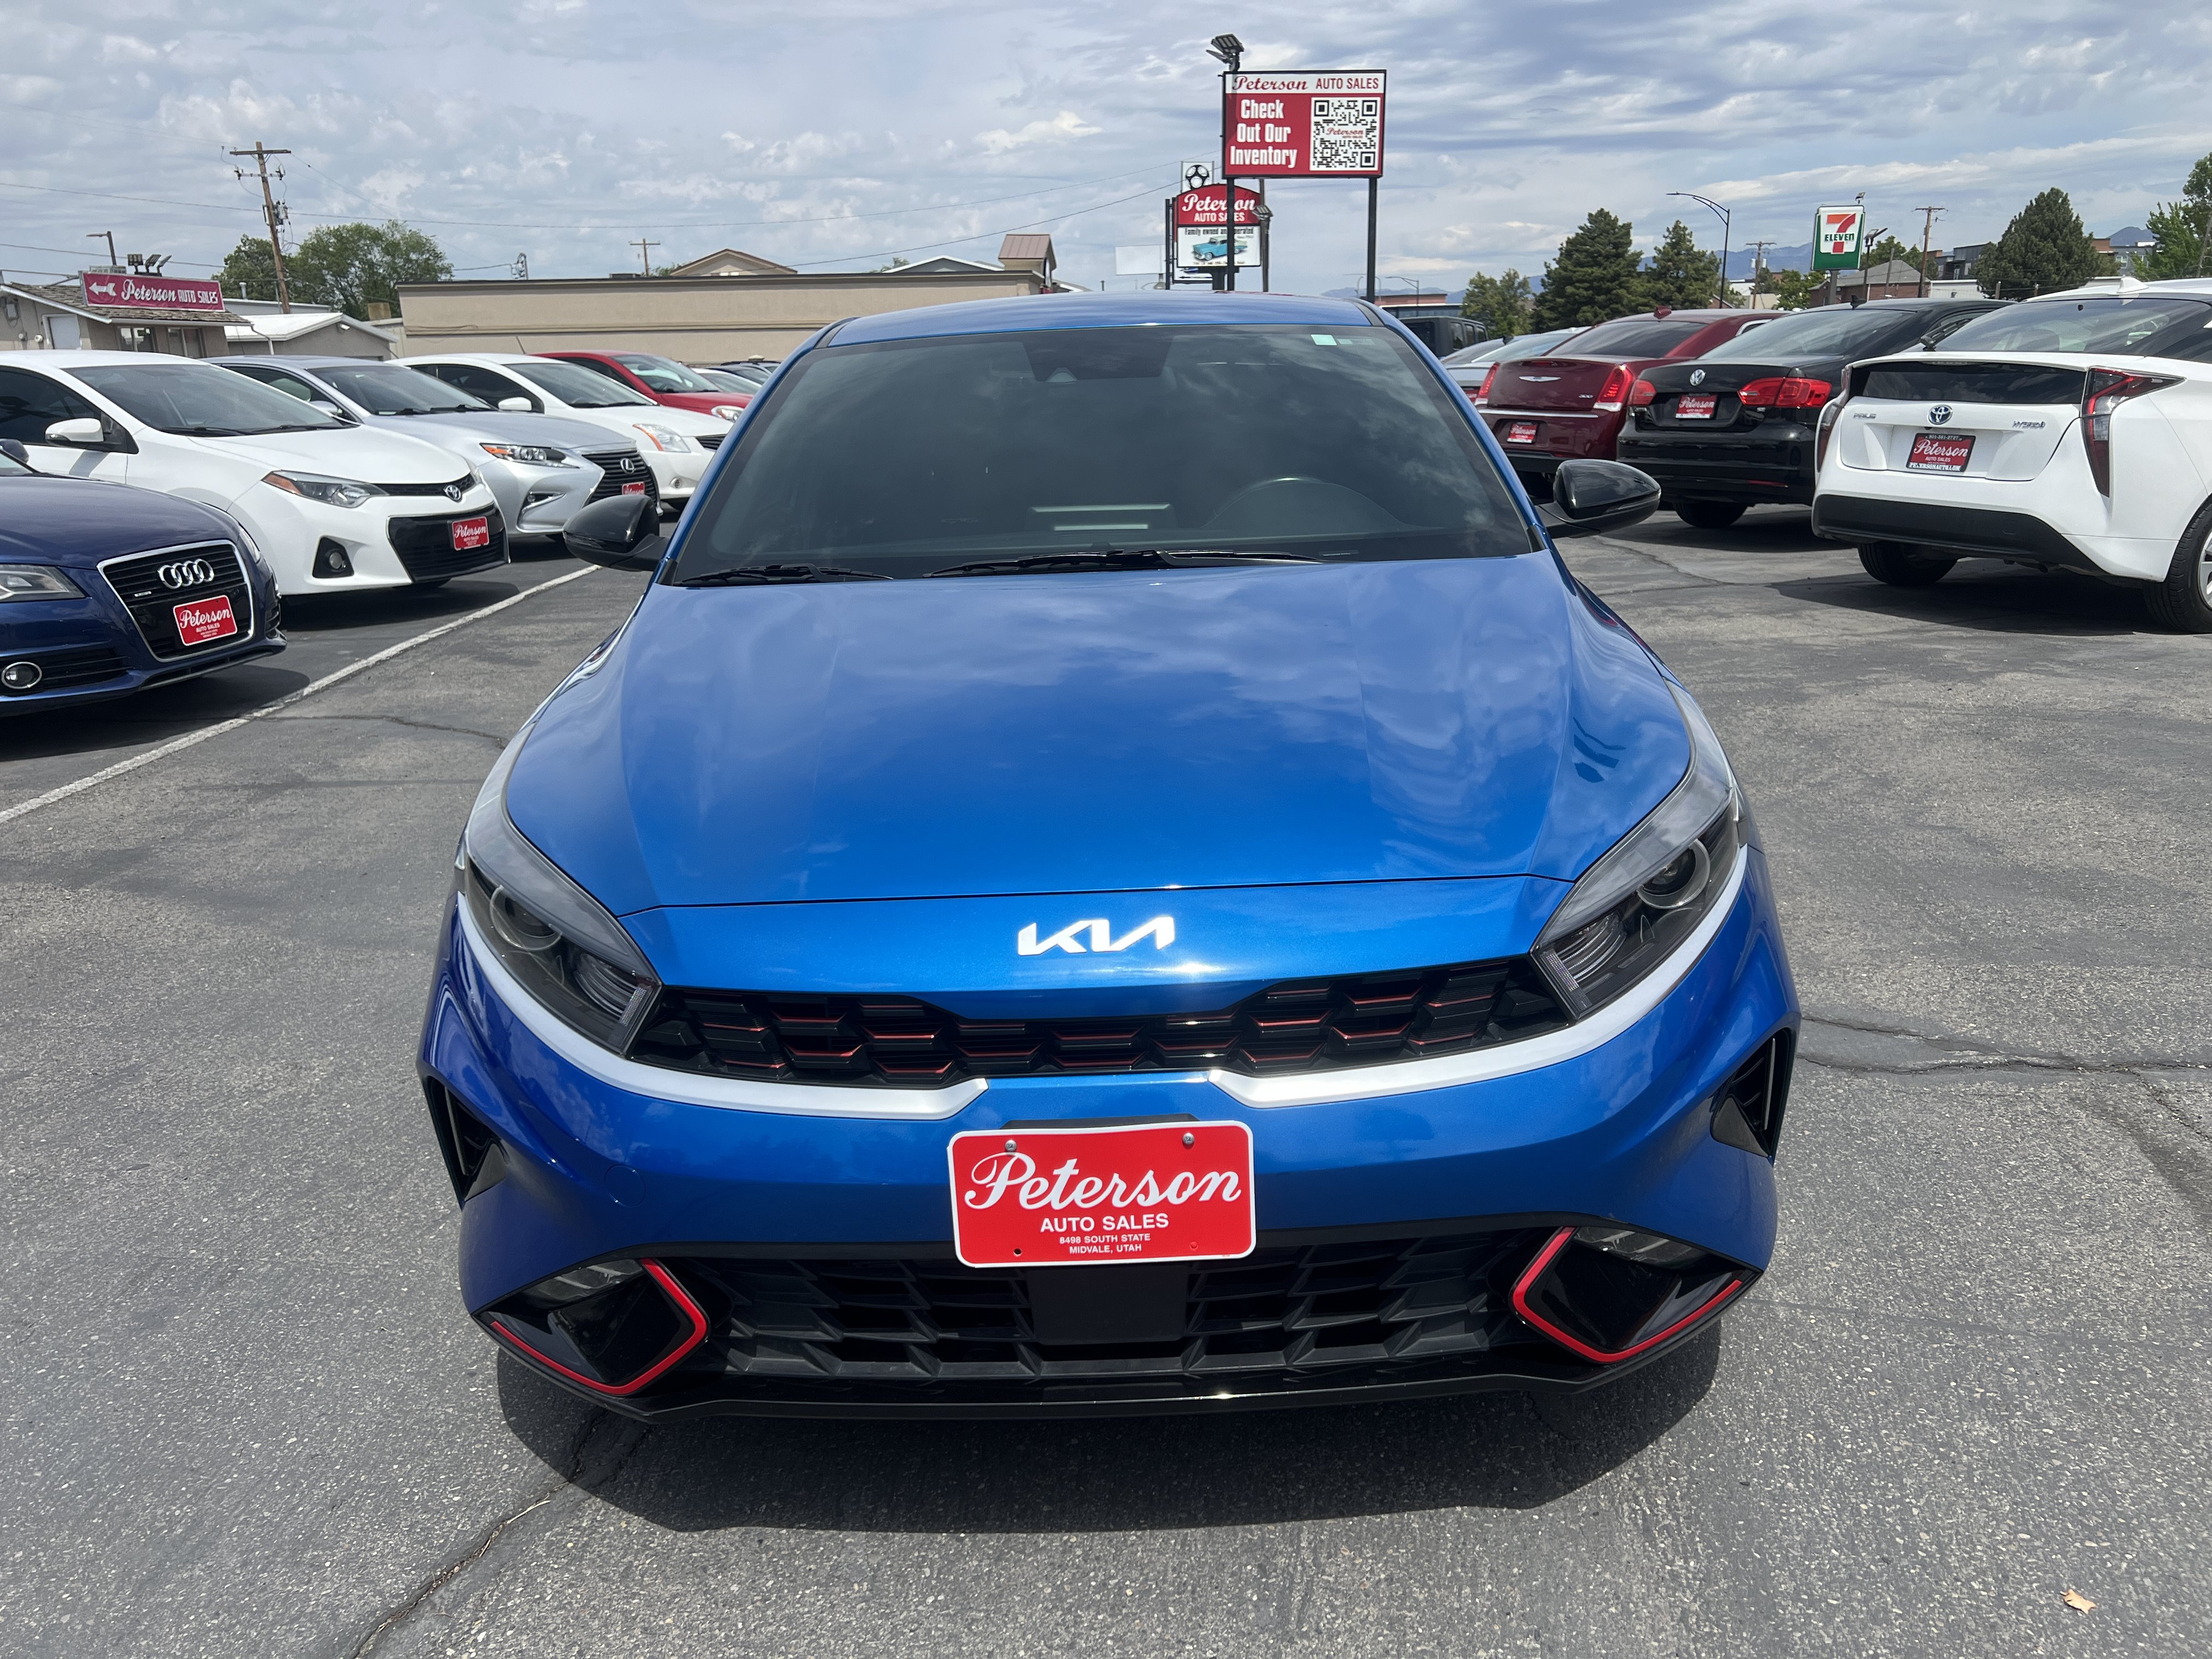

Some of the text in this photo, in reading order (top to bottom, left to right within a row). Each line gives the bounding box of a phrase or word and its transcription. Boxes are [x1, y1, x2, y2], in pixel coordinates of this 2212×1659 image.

[1232, 76, 1379, 91] Peterson AUTO SALES
[1240, 99, 1284, 119] Check
[1237, 123, 1291, 143] Out Our
[1230, 146, 1297, 168] Inventory
[1182, 194, 1256, 212] Peteron
[1194, 212, 1245, 222] AUTO SAES
[1184, 228, 1201, 236] Family
[1826, 213, 1856, 253] 7
[121, 279, 218, 304] Peterson AUTO SALES
[1679, 397, 1715, 408] Peterson
[1914, 439, 1968, 457] Peterson
[454, 524, 486, 538] Peterson
[179, 608, 231, 629] Peterson
[964, 1152, 1242, 1210] Peterson
[1040, 1213, 1169, 1233] AUTO SALES
[1059, 1233, 1150, 1244] 8498 SOUTH STATE
[1069, 1244, 1142, 1254] MIDVALE, UTAH
